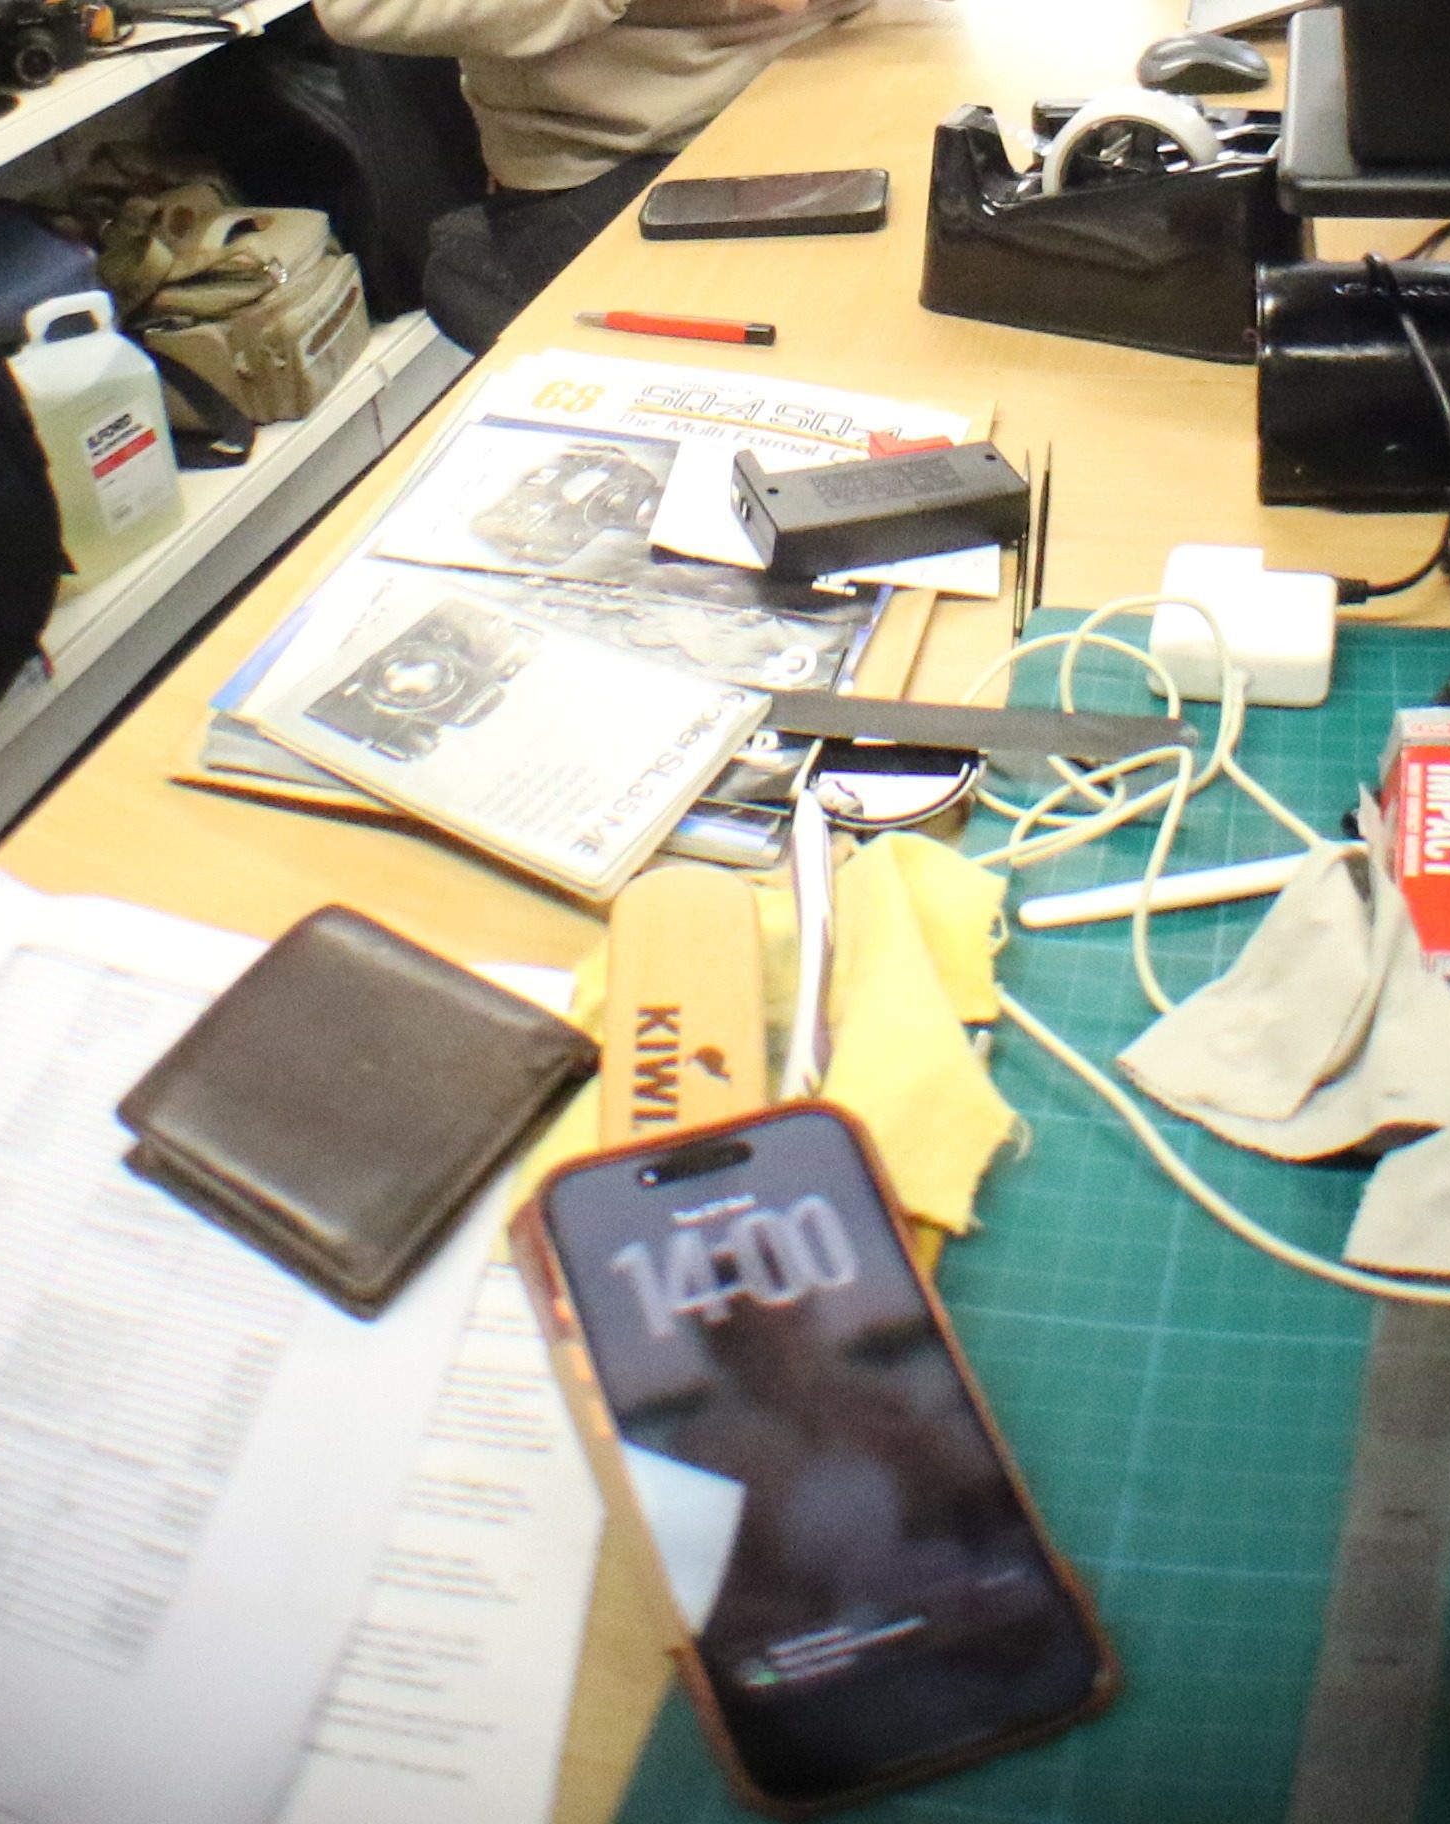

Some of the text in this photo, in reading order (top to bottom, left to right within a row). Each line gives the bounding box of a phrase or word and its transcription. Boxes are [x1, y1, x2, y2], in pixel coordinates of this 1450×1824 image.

[634, 384, 766, 421] SQ-A
[618, 413, 657, 428] The
[665, 420, 726, 439] Multi
[733, 430, 821, 458] Format
[630, 1004, 682, 1126] KIWI
